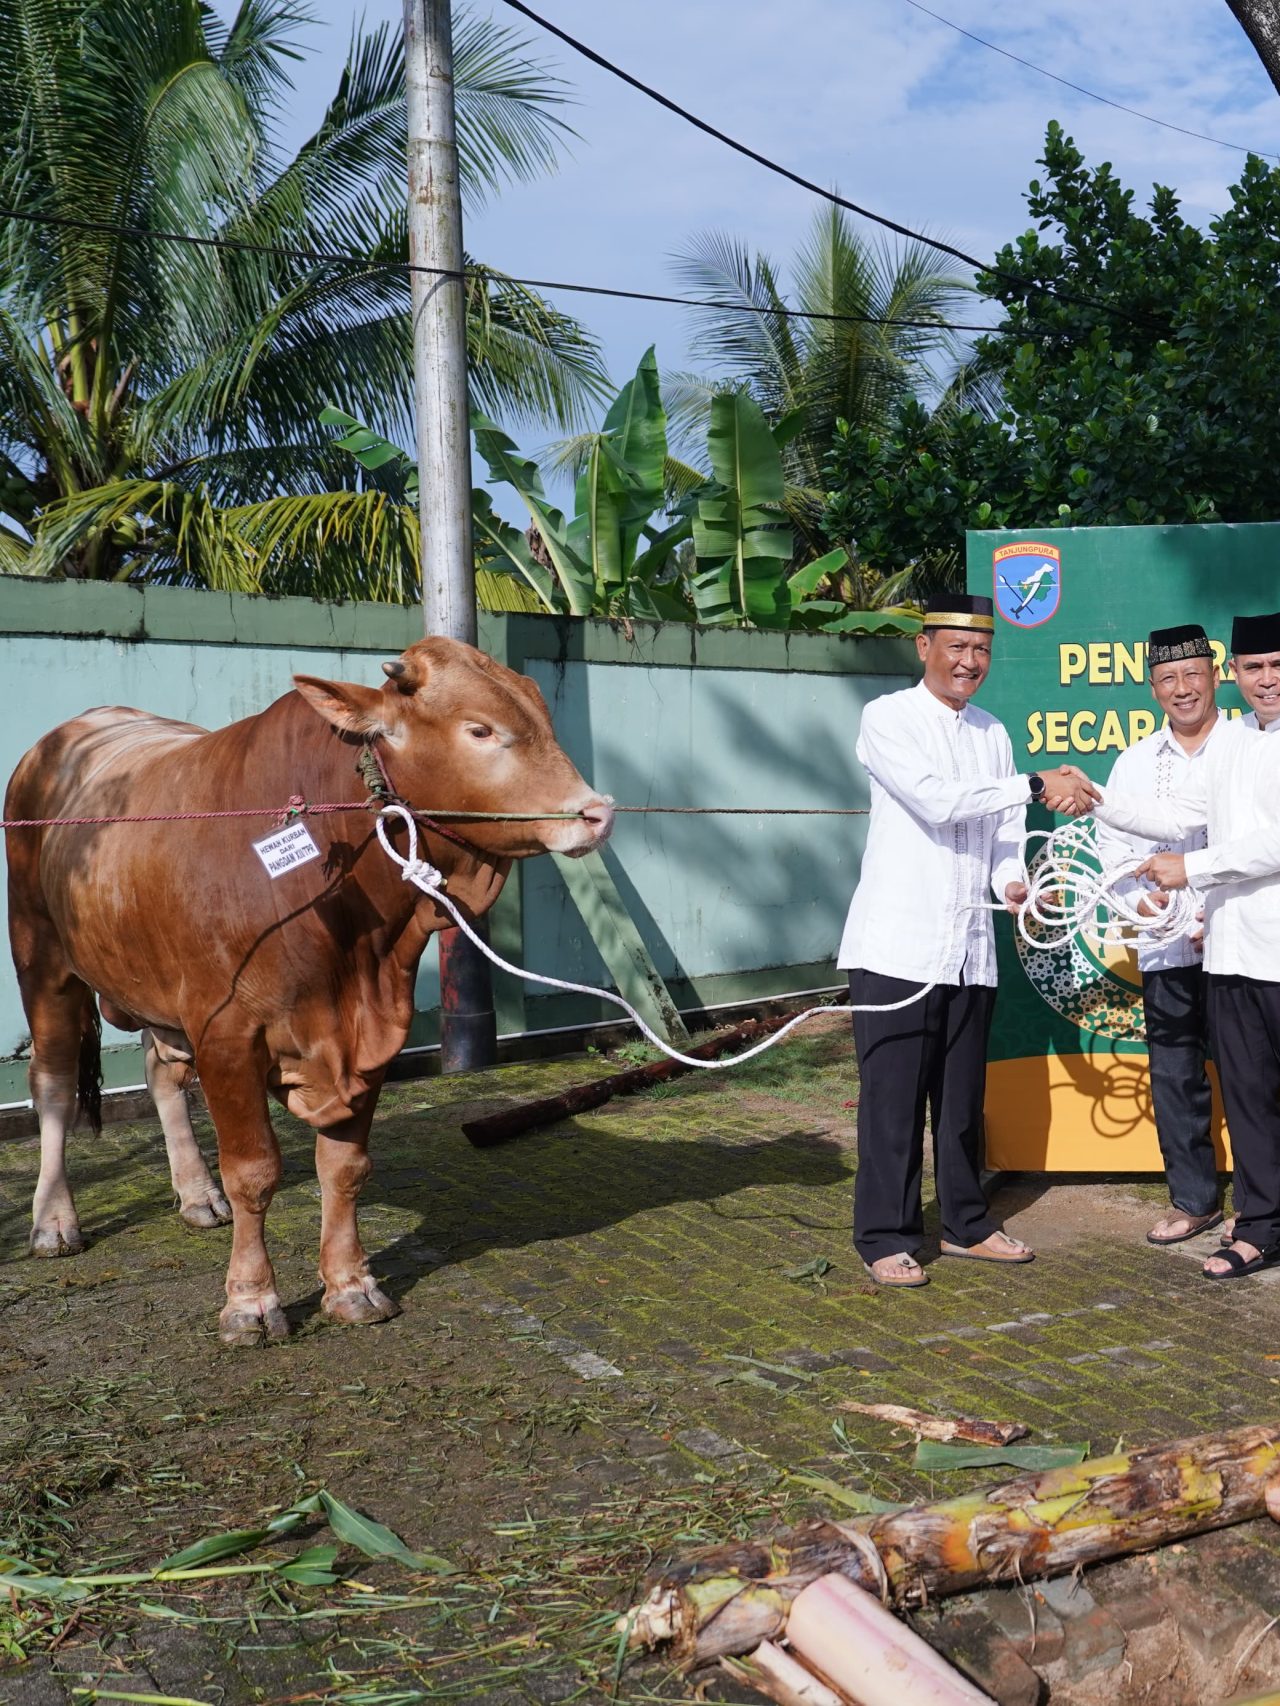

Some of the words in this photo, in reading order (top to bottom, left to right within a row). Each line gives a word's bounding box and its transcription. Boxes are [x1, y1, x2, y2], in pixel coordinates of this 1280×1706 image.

[998, 545, 1054, 557] TANJUNGPURA
[1026, 709, 1169, 755] SECAR
[260, 839, 282, 855] HEWAN
[281, 828, 306, 844] KURBAN
[279, 843, 295, 855] DARI
